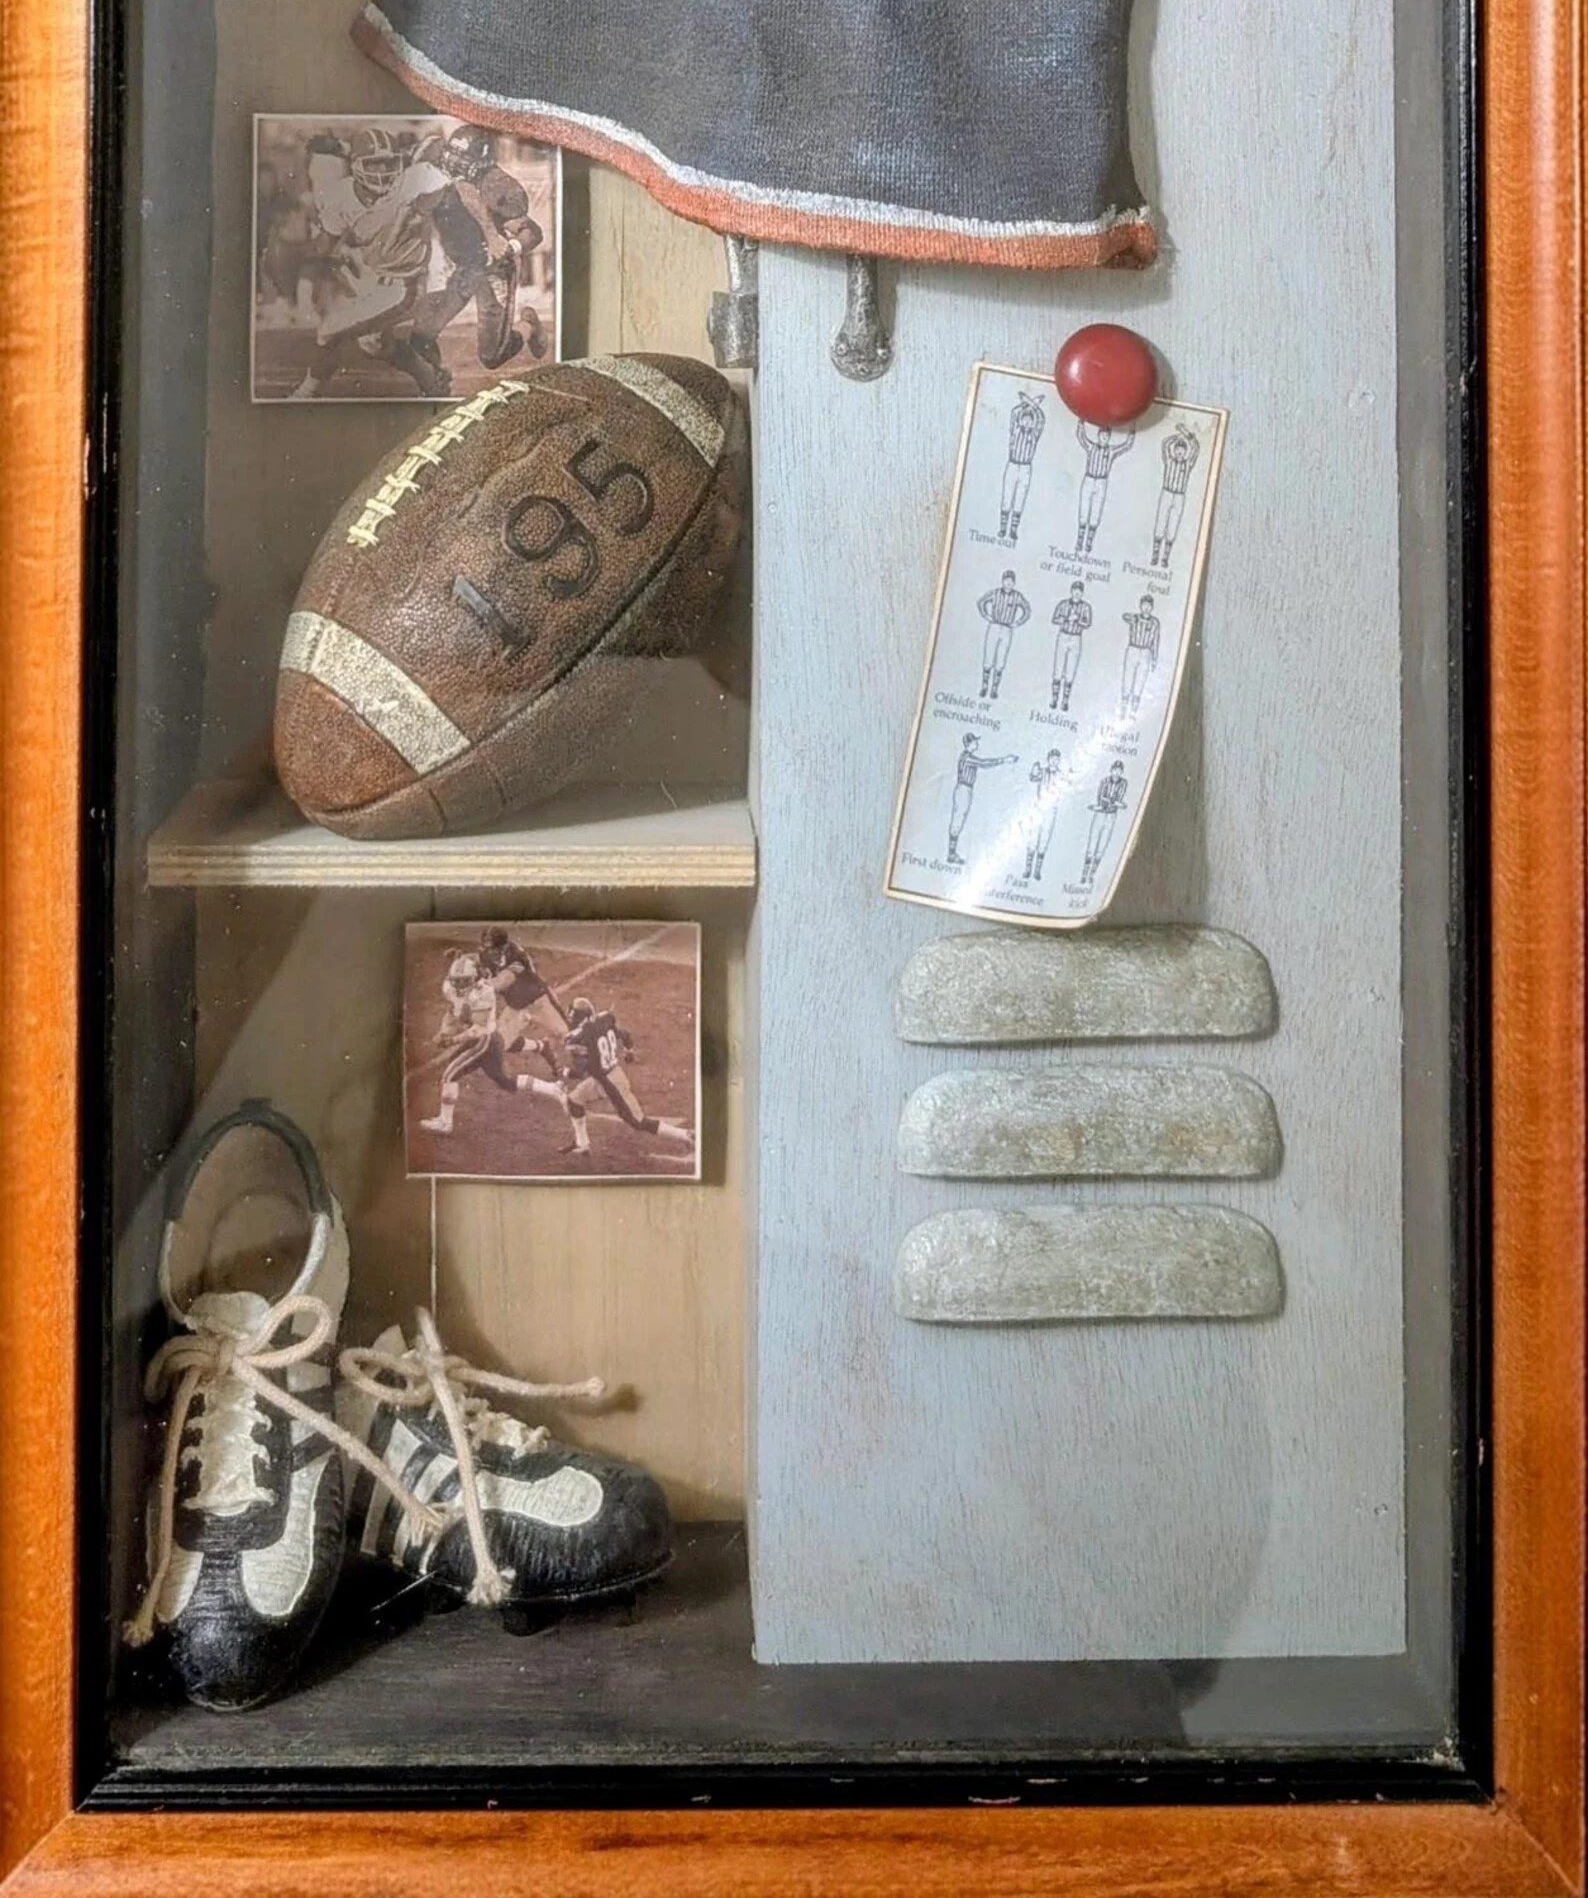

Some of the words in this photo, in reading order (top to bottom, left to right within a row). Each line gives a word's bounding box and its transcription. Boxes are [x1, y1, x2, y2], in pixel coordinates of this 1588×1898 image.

[451, 437, 656, 658] 195
[969, 528, 997, 544] Time
[997, 537, 1016, 550] out
[1048, 545, 1112, 569] Touchdown
[1040, 561, 1053, 572] or
[1056, 563, 1083, 577] field
[1085, 569, 1111, 583] goal
[1122, 560, 1174, 582] Personal
[1146, 580, 1172, 596] foul
[935, 691, 977, 709] Offside
[978, 701, 991, 712] or
[933, 708, 1001, 732] encroaching
[1029, 709, 1078, 733] Holding
[901, 851, 927, 868] First
[928, 857, 962, 875] down
[1004, 872, 1029, 889] Pass
[982, 888, 1044, 907] terference
